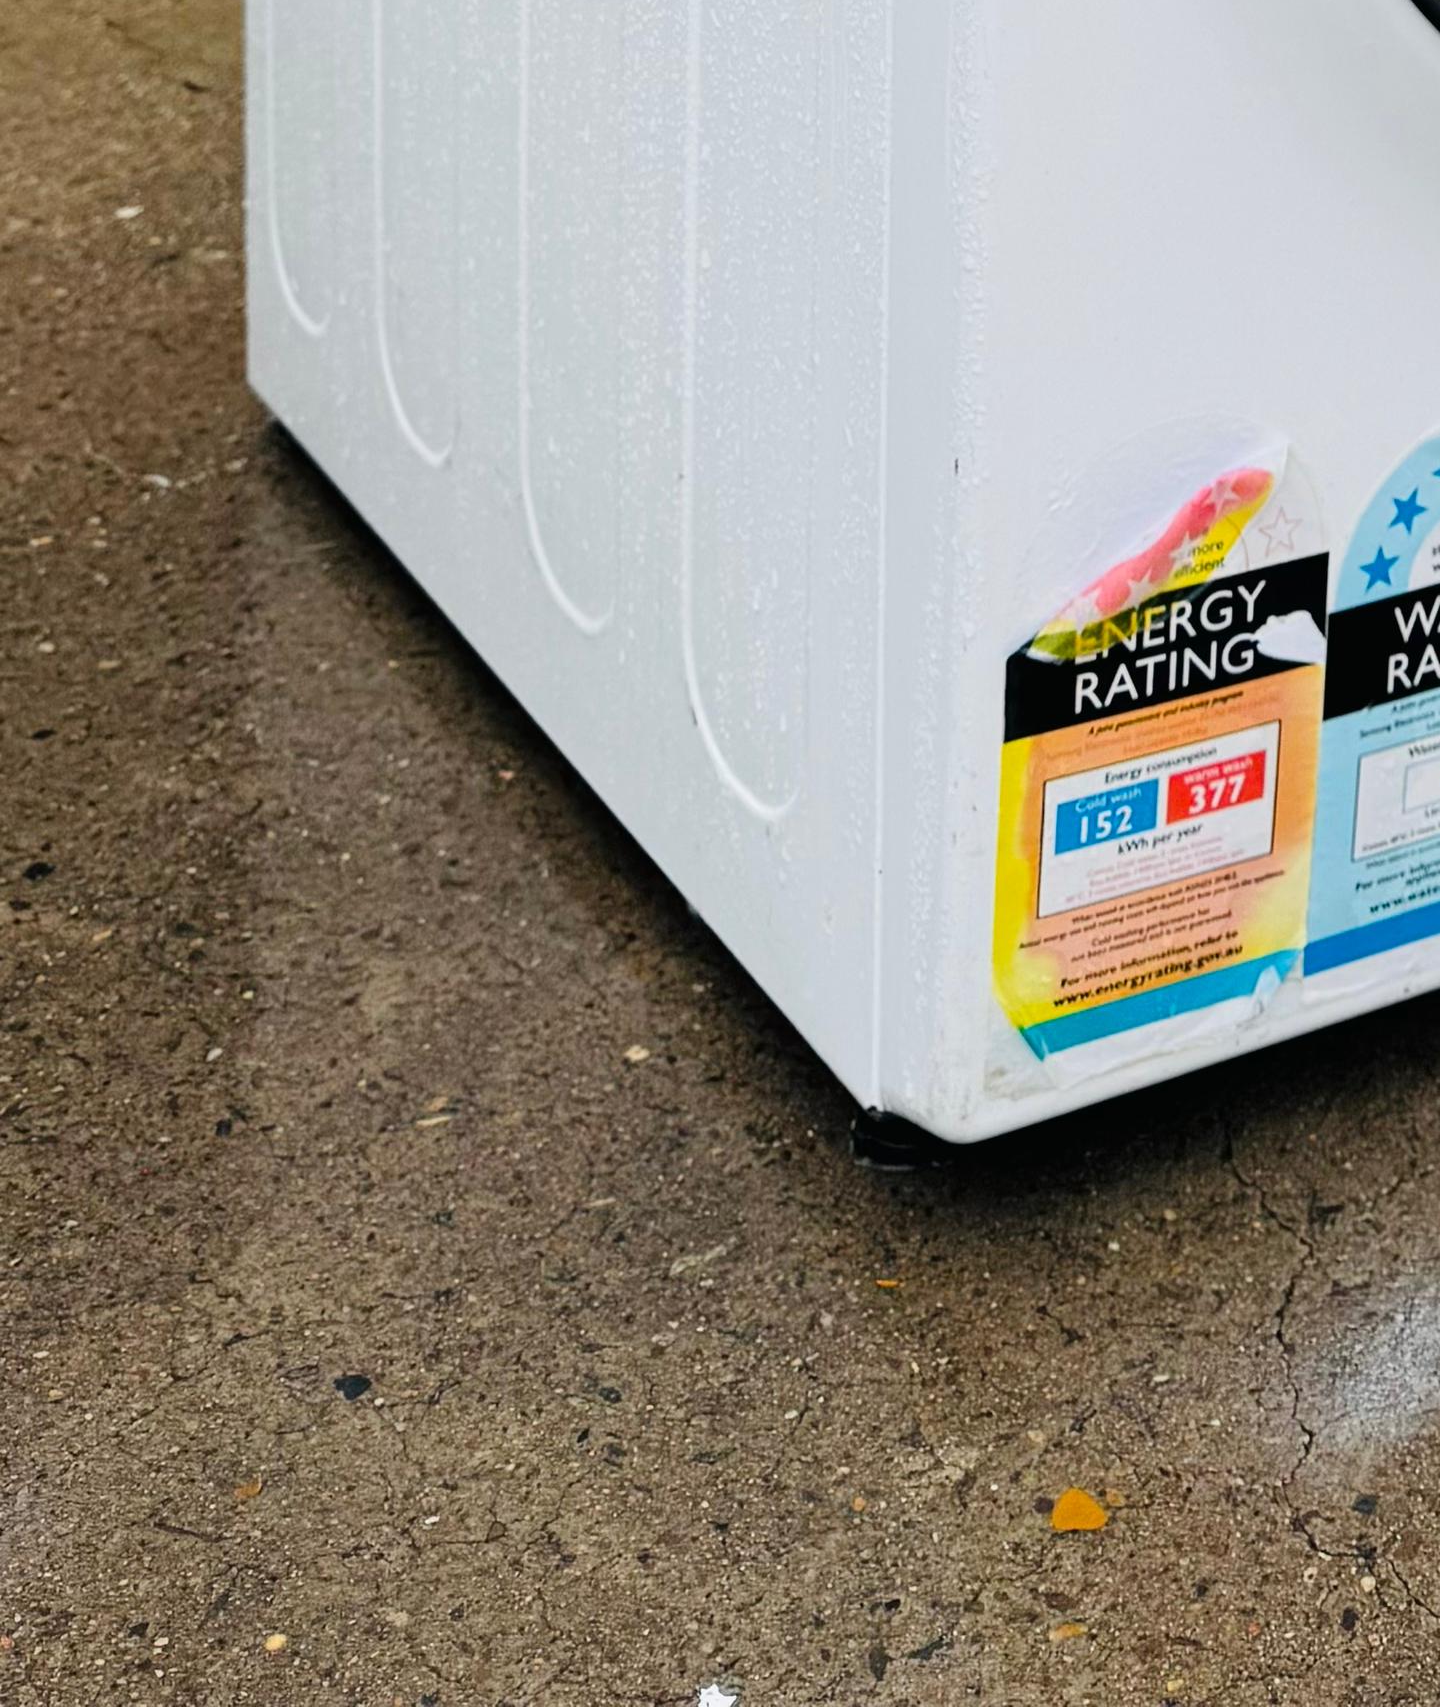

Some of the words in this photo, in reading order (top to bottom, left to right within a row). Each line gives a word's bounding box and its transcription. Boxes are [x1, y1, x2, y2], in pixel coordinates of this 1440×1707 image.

[1074, 580, 1266, 665] ENERGY
[1074, 633, 1258, 714] RATING
[1104, 767, 1143, 784] Energy
[1188, 774, 1246, 815] 377
[1075, 793, 1107, 813] Cold
[1110, 787, 1142, 804] wash
[1079, 805, 1134, 844] 152
[1117, 837, 1149, 855] kWh
[1152, 833, 1172, 849] per
[1175, 822, 1203, 842] year
[1053, 945, 1244, 1008] www.energyrating.gov.au
[1060, 976, 1081, 989] For
[1084, 964, 1117, 981] more
[1194, 935, 1223, 950] refer
[1225, 930, 1240, 941] to
